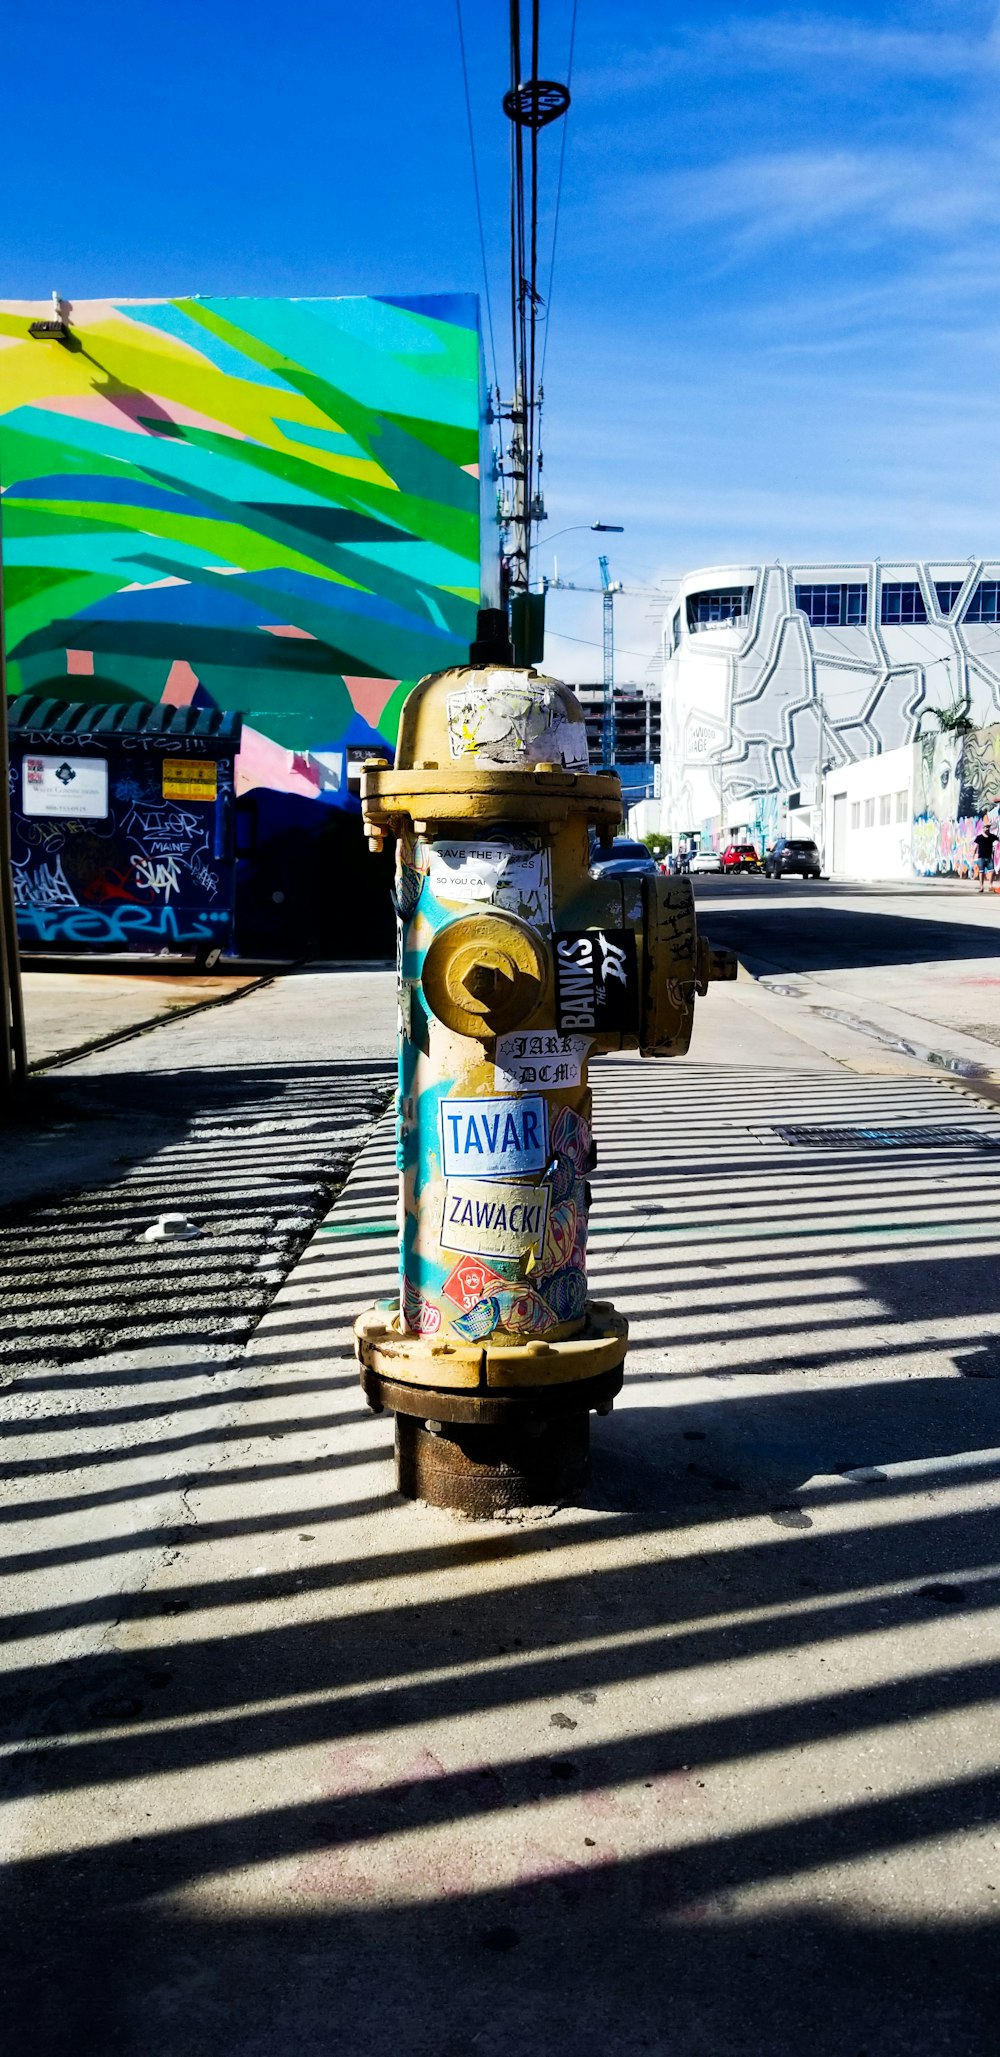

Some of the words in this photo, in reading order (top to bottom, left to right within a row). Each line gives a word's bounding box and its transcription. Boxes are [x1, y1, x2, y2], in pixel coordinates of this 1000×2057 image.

[151, 842, 192, 853] MAINE
[437, 849, 466, 859] SAVE
[469, 850, 492, 860] THE
[594, 929, 629, 988] DJ
[557, 938, 595, 1029] BANKS
[596, 985, 606, 1005] THE
[447, 1110, 541, 1154] TAVAR
[449, 1196, 541, 1233] ZAWACKI
[463, 1296, 479, 1309] 30
